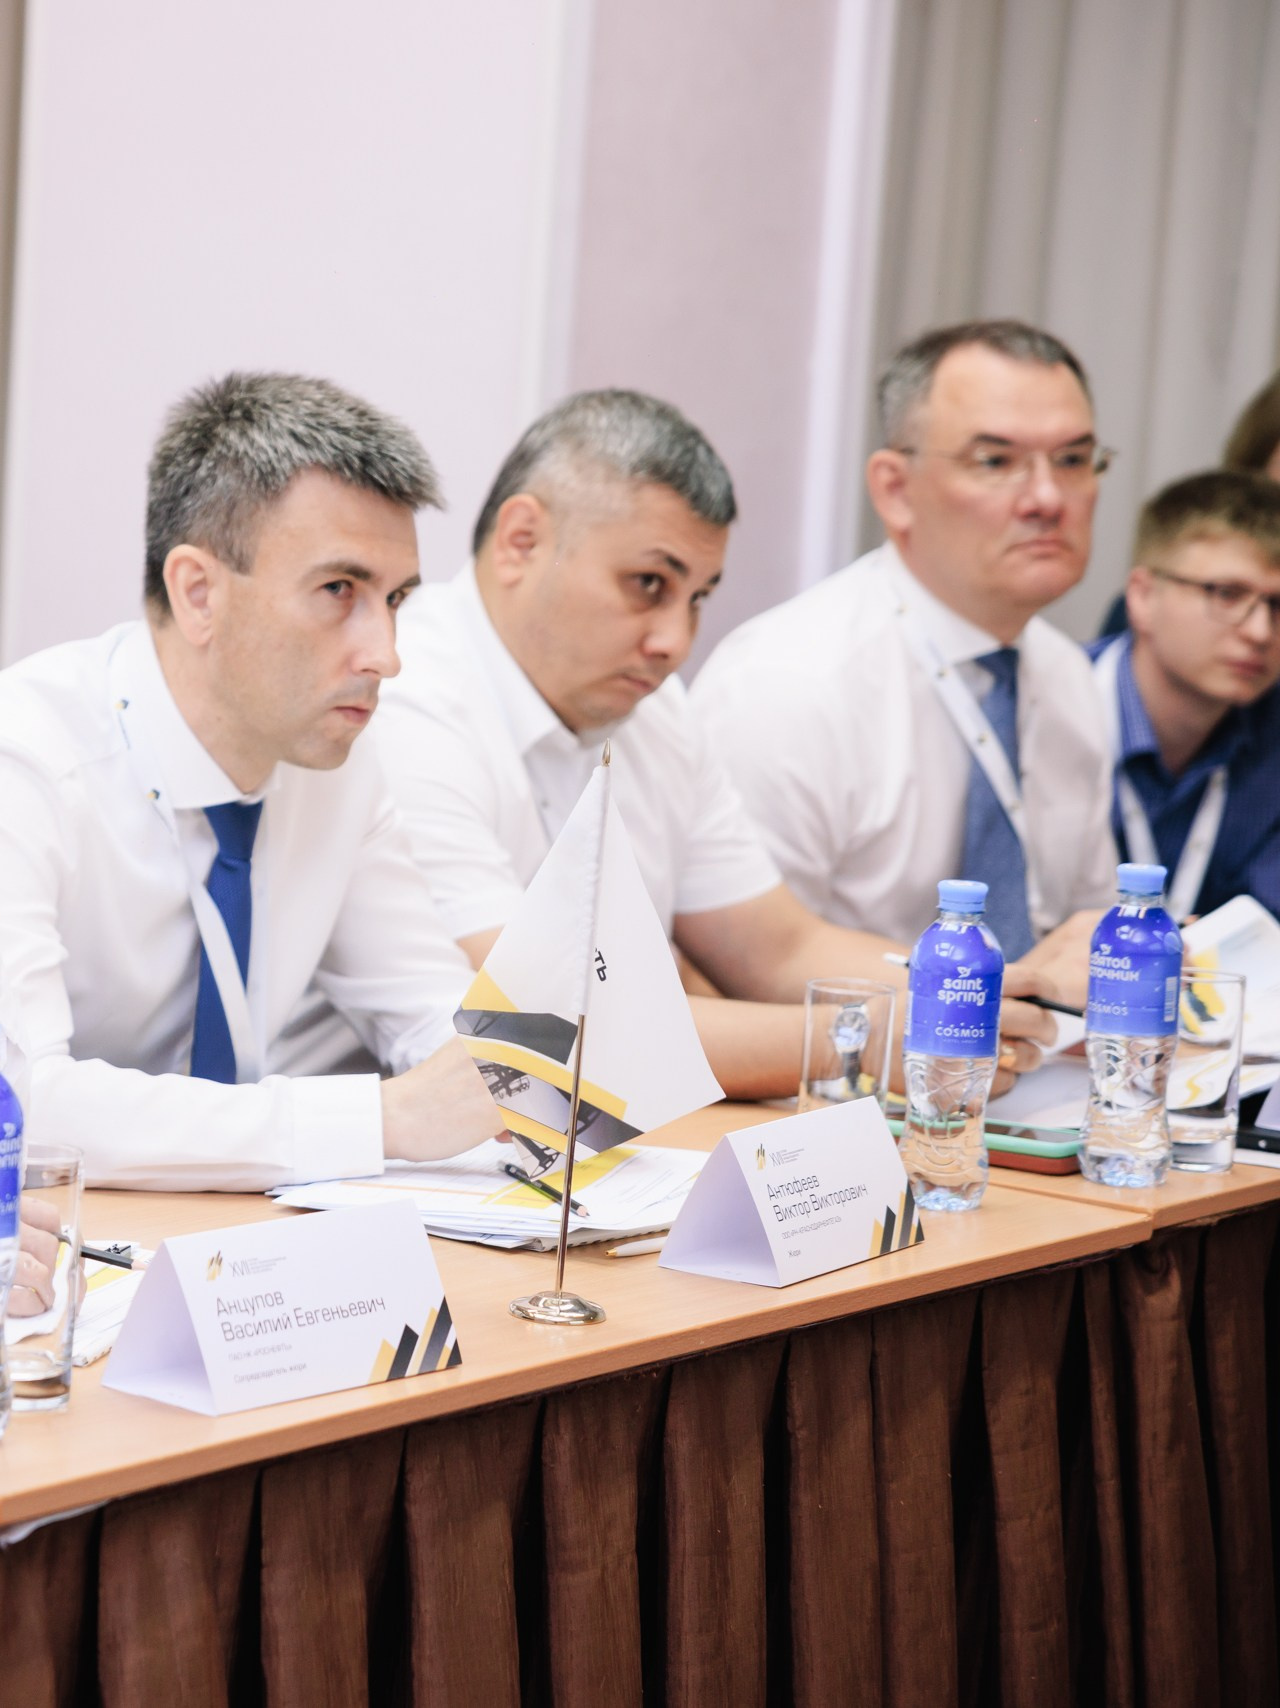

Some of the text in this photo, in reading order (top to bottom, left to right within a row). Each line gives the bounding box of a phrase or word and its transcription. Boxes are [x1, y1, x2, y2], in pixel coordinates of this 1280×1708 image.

[943, 977, 983, 990] saint
[937, 989, 986, 1007] spring
[935, 1025, 985, 1038] COSMOS
[766, 1175, 820, 1201] Антюфеев
[773, 1184, 868, 1222] Виктор Викторович
[216, 1291, 285, 1317] Анцупов
[221, 1297, 386, 1342] Василий Евгеньевич
